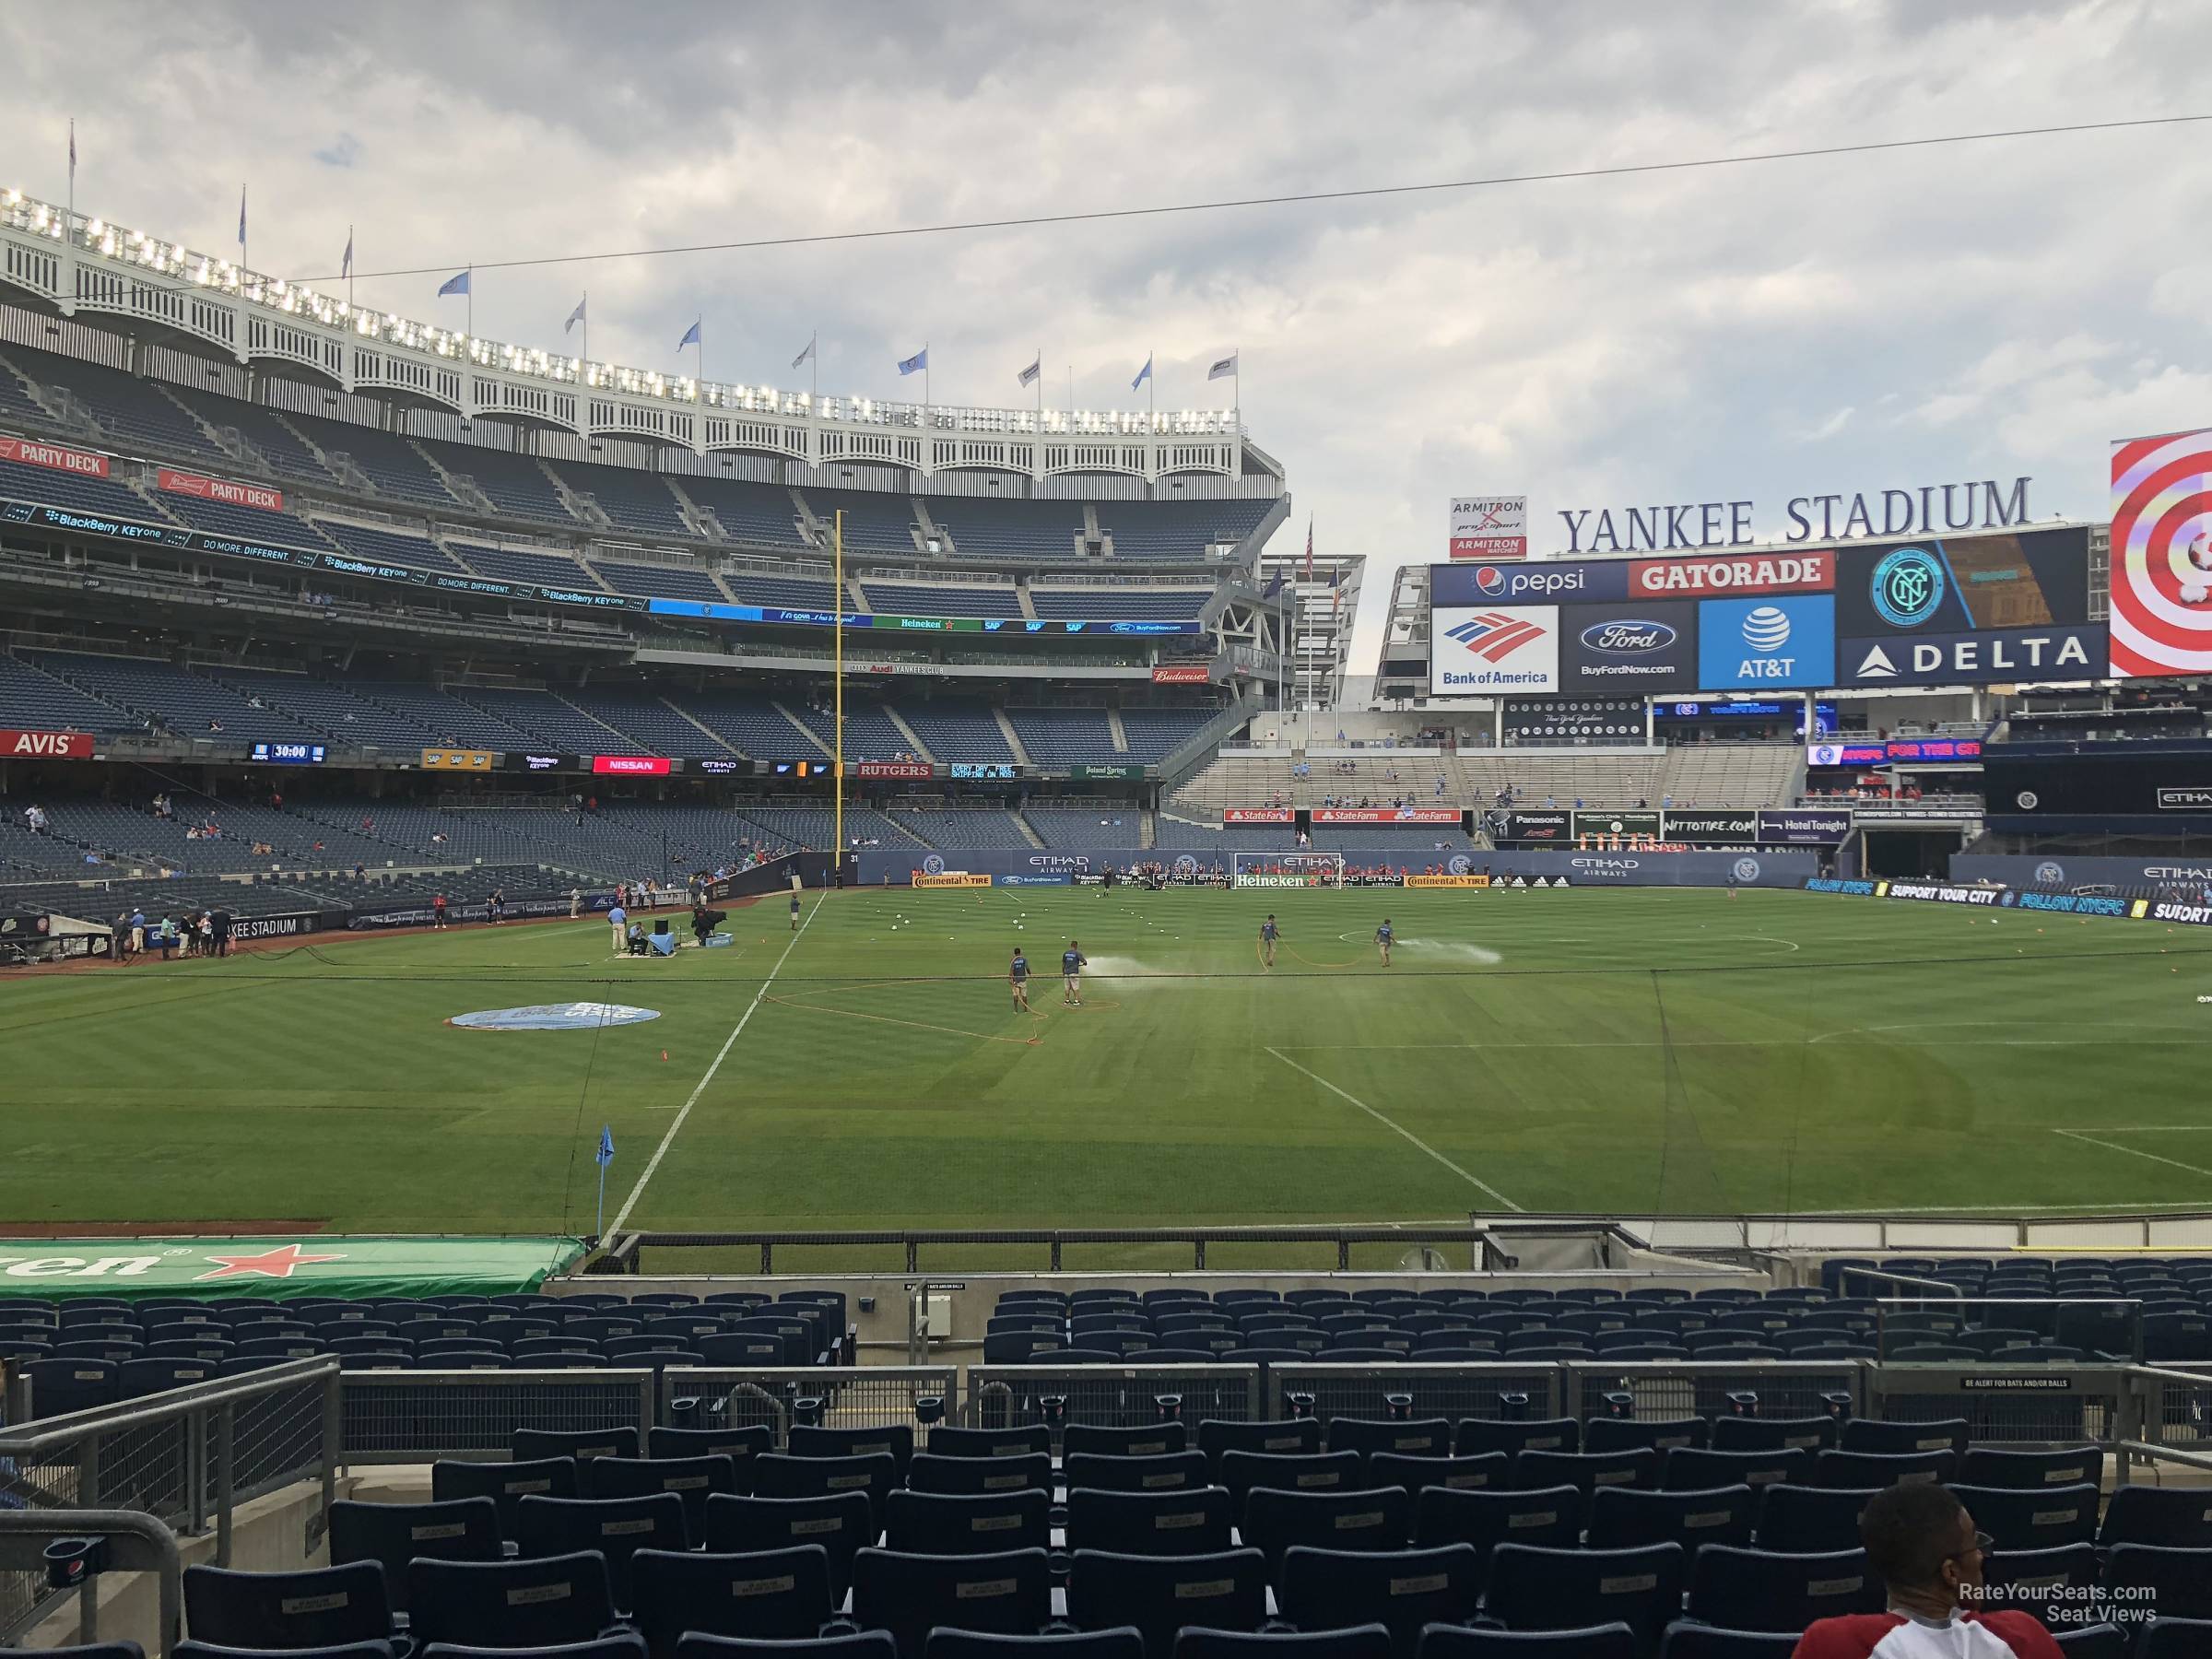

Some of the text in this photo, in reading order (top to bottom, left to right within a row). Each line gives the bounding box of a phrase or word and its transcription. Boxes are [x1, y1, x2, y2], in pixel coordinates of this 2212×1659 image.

[21, 444, 62, 465] PARTY
[66, 453, 100, 473] DECK
[211, 482, 275, 507] PARTY DECK
[1453, 502, 1523, 513] ARMITRON
[1558, 477, 2032, 554] YANKEE STADIUM
[59, 513, 118, 535] BlackBerry
[1457, 539, 1520, 549] ARMITRON
[203, 539, 216, 549] DO
[244, 546, 289, 561] DIFFERENT.
[334, 559, 377, 577] BlackBerry
[1641, 557, 1822, 591] GATORADE
[437, 577, 447, 586] DO
[1511, 567, 1585, 595] pepsi
[550, 591, 592, 605] BlackBerry
[901, 619, 941, 629] Heineken
[984, 622, 1000, 630] SAP
[1598, 625, 1659, 649] Ford
[1913, 636, 2089, 673] DELTA
[895, 665, 925, 674] YANKEES
[927, 666, 944, 675] CLUB
[1581, 665, 1676, 676] BuyFordNow.com
[1737, 659, 1795, 679] AT&T
[1153, 671, 1208, 682] Budweiser
[1443, 671, 1547, 685] Bank of America
[14, 734, 70, 754] AVIS
[275, 746, 306, 757] 30:00
[1888, 744, 1919, 756] FOR
[1922, 744, 1953, 755] THE
[427, 755, 441, 763] SAP
[472, 756, 484, 765] SAP
[531, 756, 558, 765] BlackBerry
[610, 761, 653, 770] NISSAN
[860, 765, 929, 776] RUTGERS
[1086, 766, 1127, 775] Poland Spring
[1516, 816, 1565, 824] Panasonic
[1664, 819, 1755, 832] NITTOTIRE.COM
[1030, 856, 1089, 865] ETIHAD
[1571, 858, 1639, 869] ETIHAD
[914, 877, 962, 887] Continental
[1237, 876, 1304, 887] Heineken
[1407, 877, 1457, 887] Continental
[1890, 884, 1997, 905] SUPPORT YOUR CITY
[2019, 893, 2126, 916] FOLLOW NYCFC
[252, 918, 296, 936] STADIUM
